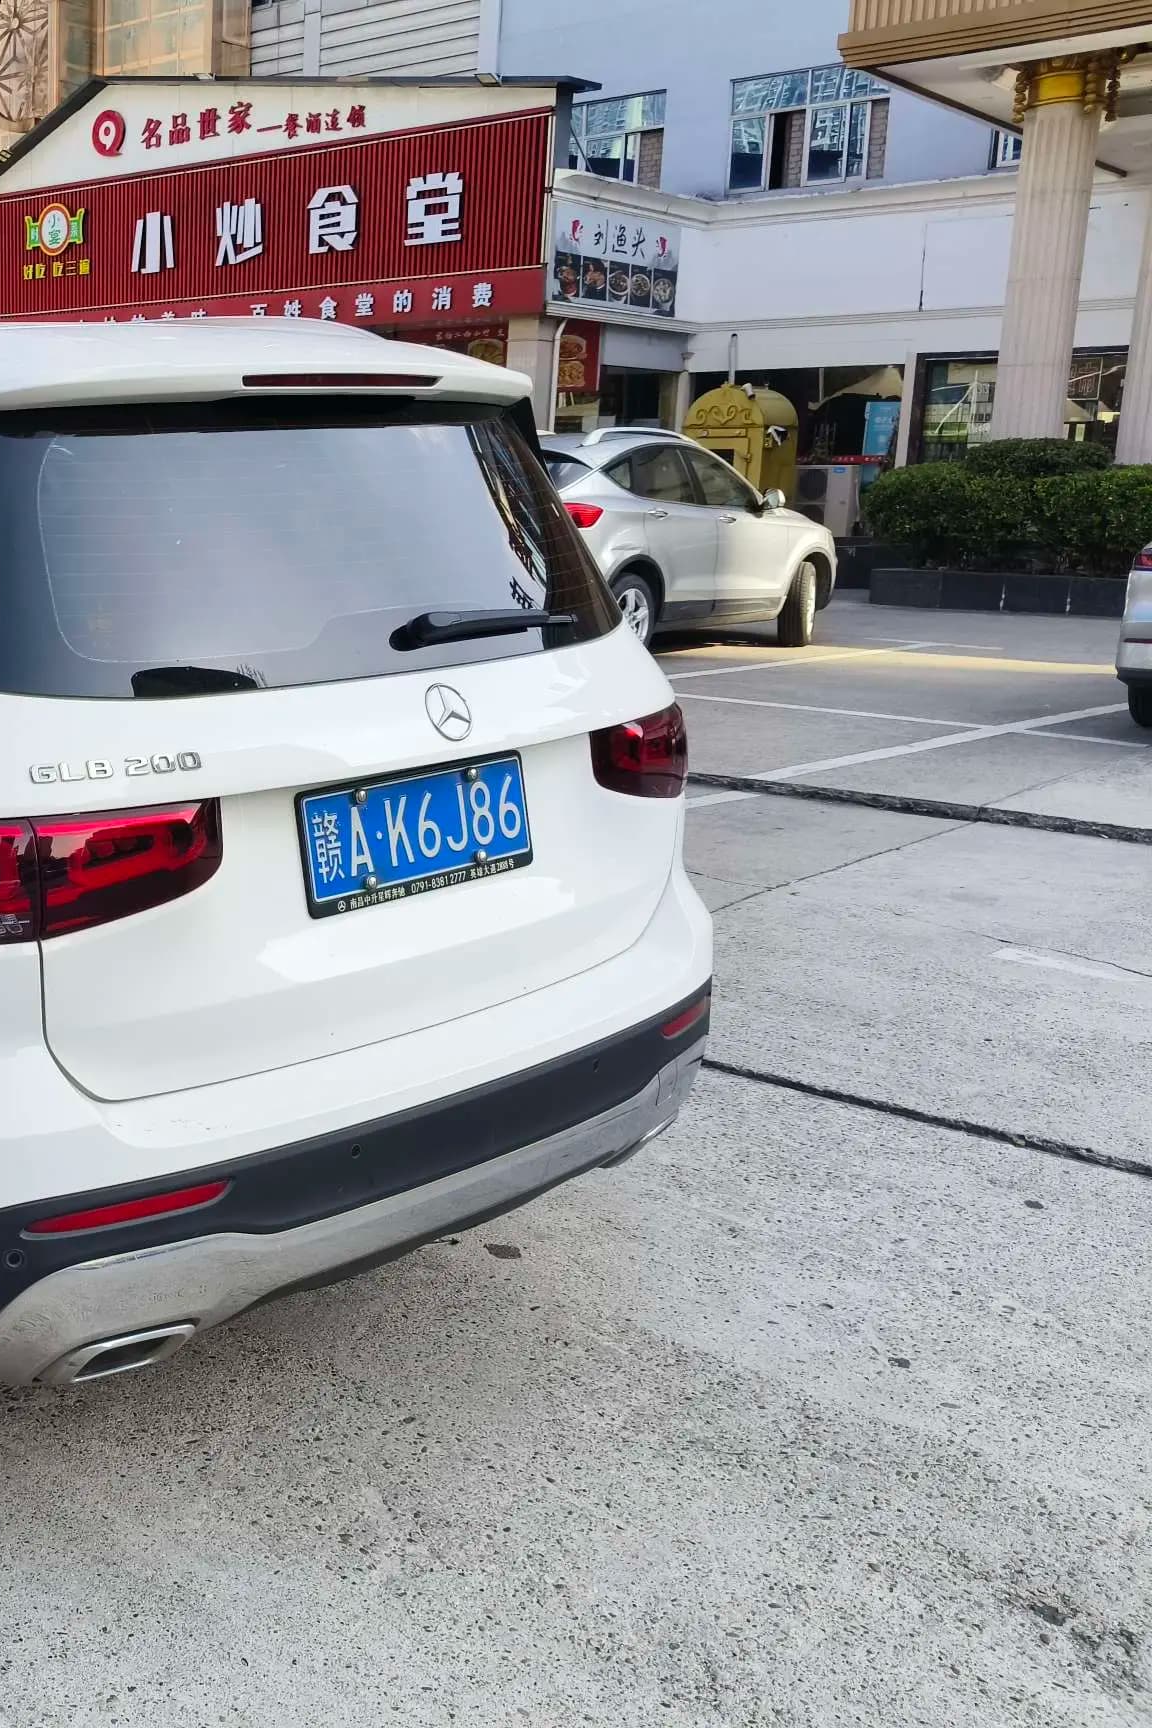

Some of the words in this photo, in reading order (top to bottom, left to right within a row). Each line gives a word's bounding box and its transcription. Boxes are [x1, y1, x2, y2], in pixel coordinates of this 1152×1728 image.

[131, 172, 464, 274] 小炒食堂
[250, 282, 493, 319] 百姓食堂的消费
[29, 759, 114, 784] GLB
[124, 751, 202, 777] 200
